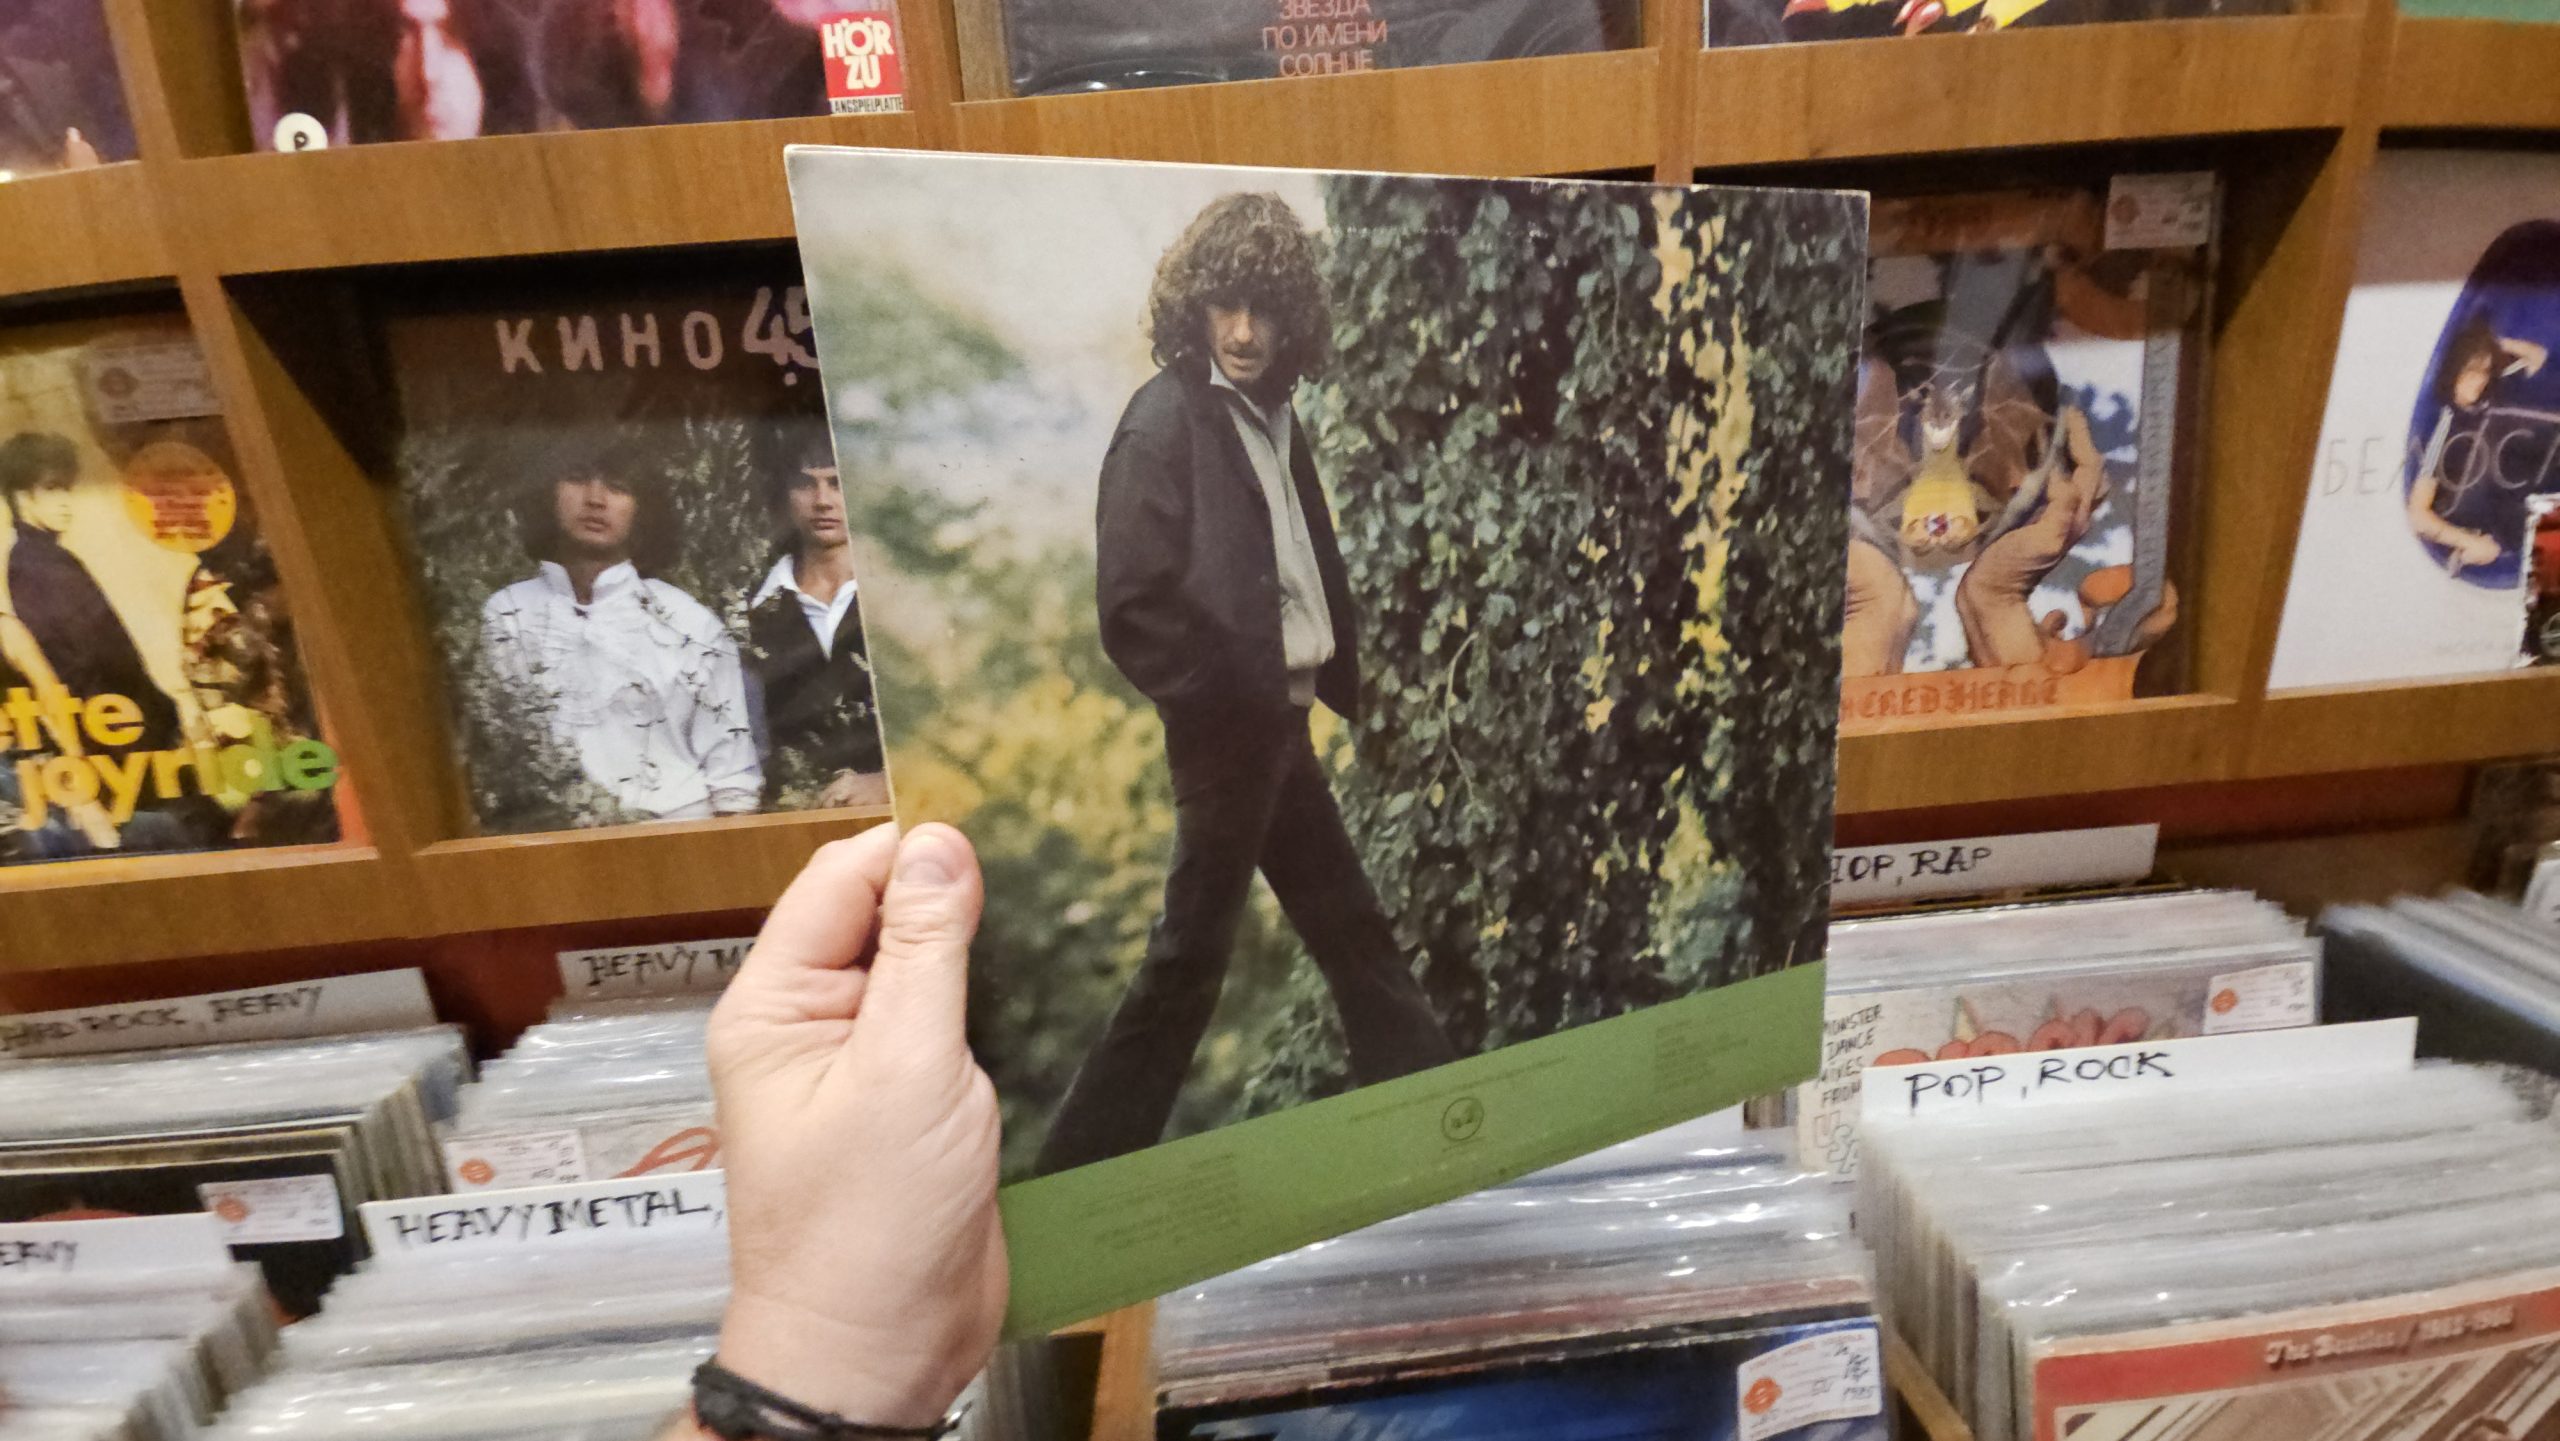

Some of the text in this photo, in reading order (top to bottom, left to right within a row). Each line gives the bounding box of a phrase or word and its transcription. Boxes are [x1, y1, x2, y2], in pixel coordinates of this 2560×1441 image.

[1279, 0, 1372, 20] ЗВЕЗДА
[822, 17, 895, 58] HÖR
[1262, 20, 1388, 50] ПО ИМЕНИ
[843, 55, 881, 90] ZU
[496, 310, 723, 374] КИНО
[0, 685, 145, 750] tte
[17, 704, 340, 832] joyride
[1910, 845, 1991, 877] RAP
[581, 946, 699, 987] HEAVY
[2037, 1051, 2175, 1088] ROCK
[388, 1203, 535, 1250] HEAVY
